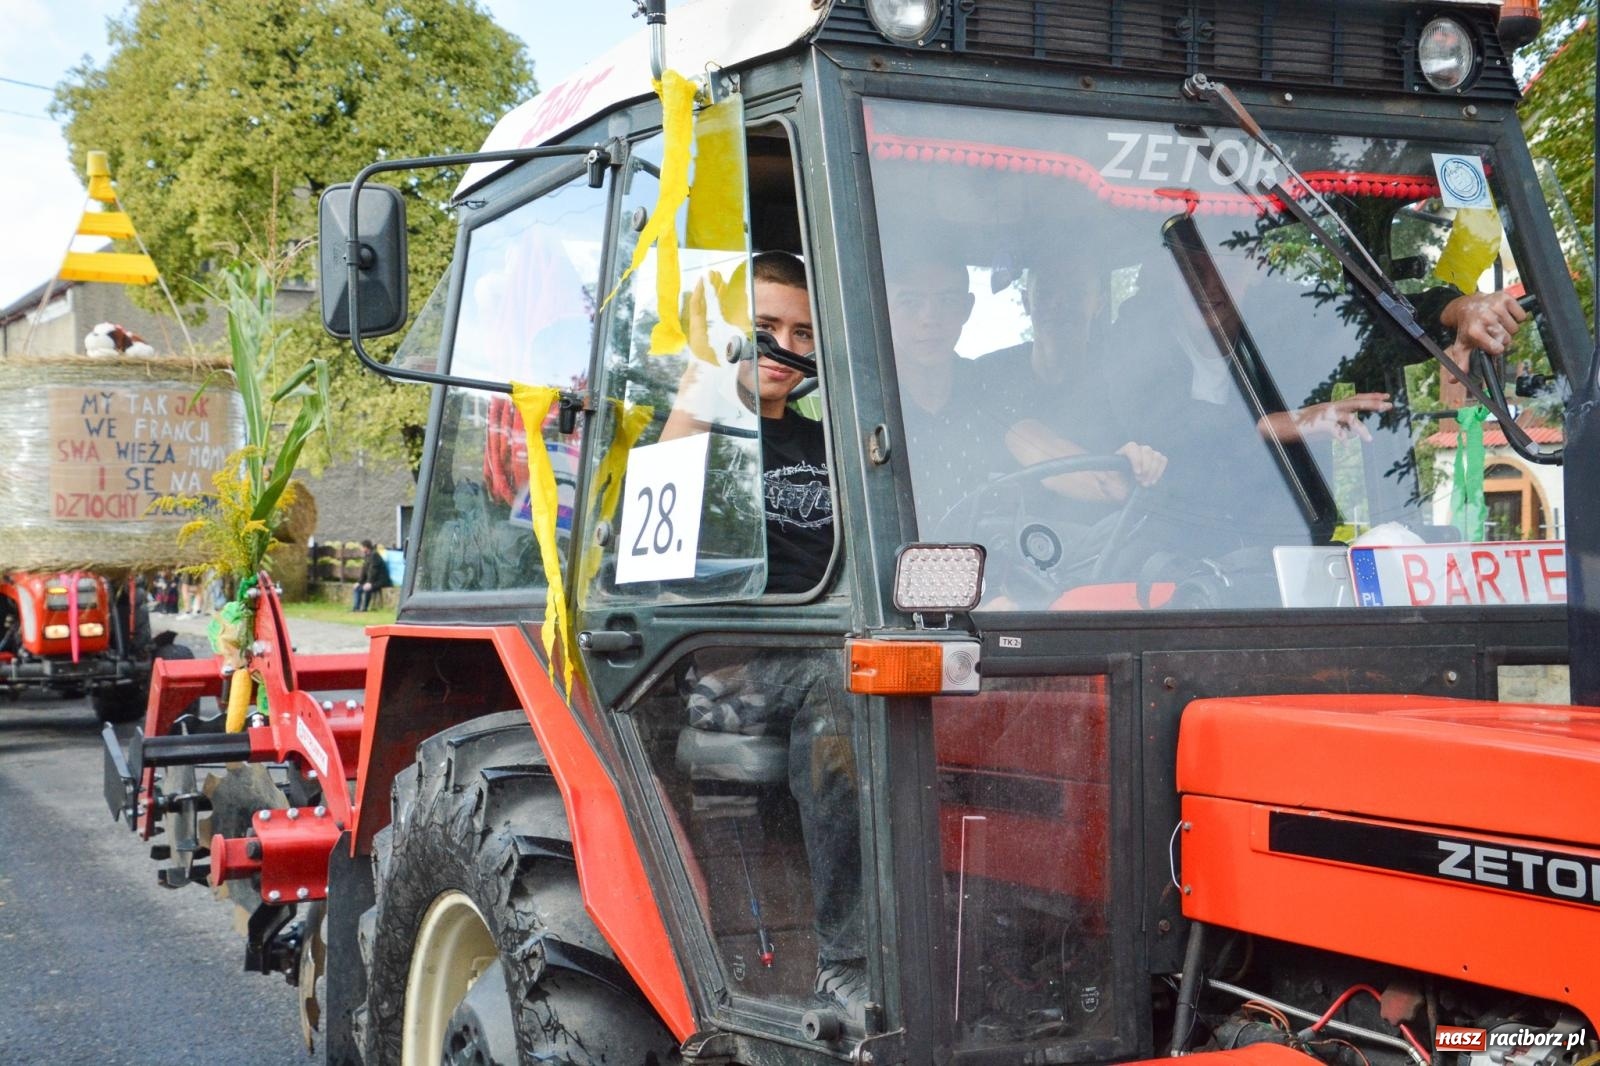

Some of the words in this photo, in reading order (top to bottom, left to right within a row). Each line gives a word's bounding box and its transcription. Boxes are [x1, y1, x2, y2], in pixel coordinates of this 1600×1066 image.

[1101, 132, 1284, 188] ZETOR
[81, 392, 114, 414] MY
[126, 393, 168, 415] TAK
[85, 418, 117, 438] WE
[134, 419, 209, 443] FRANCJI
[98, 467, 105, 491] I
[125, 467, 155, 491] SE
[170, 471, 201, 492] NA
[631, 482, 683, 557] 28.
[1361, 592, 1381, 607] PL
[1438, 840, 1600, 901] ZETO
